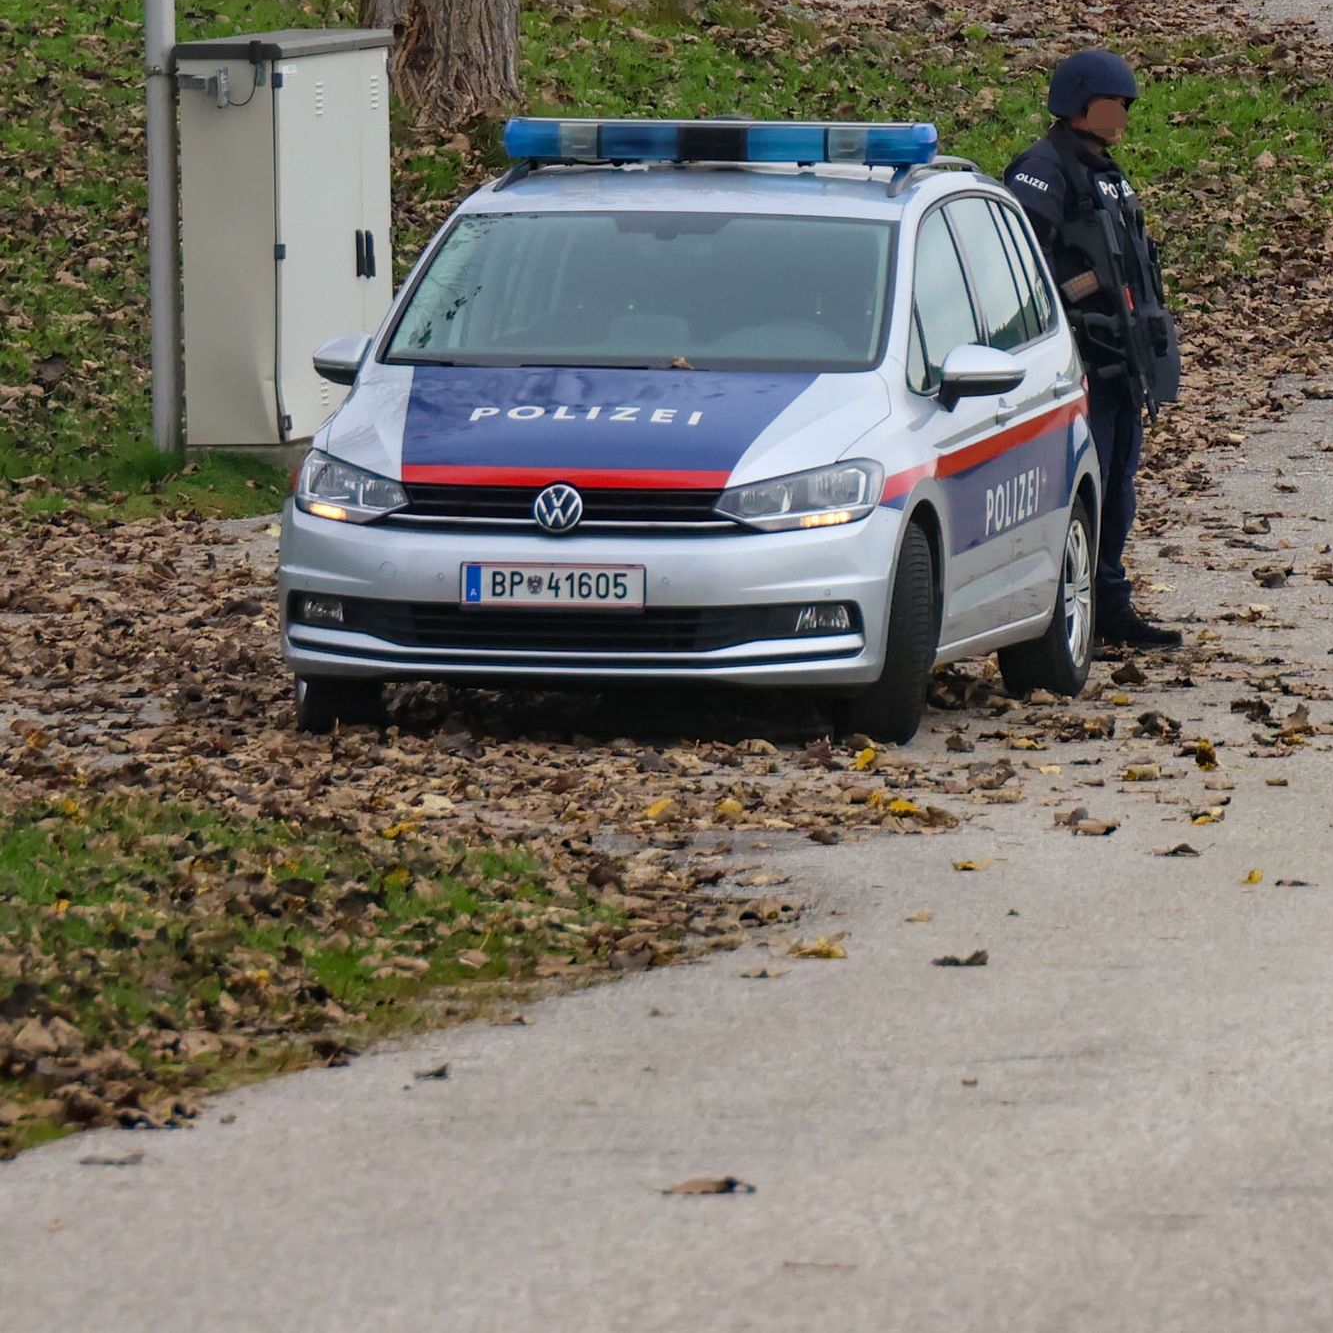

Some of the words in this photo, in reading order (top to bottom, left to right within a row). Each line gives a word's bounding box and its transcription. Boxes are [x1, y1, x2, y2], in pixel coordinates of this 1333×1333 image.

[1015, 173, 1049, 191] OLIZEI
[469, 405, 704, 425] POLIZEI
[985, 466, 1040, 536] POLIZEI
[491, 570, 524, 597] BP
[547, 571, 628, 599] 41605
